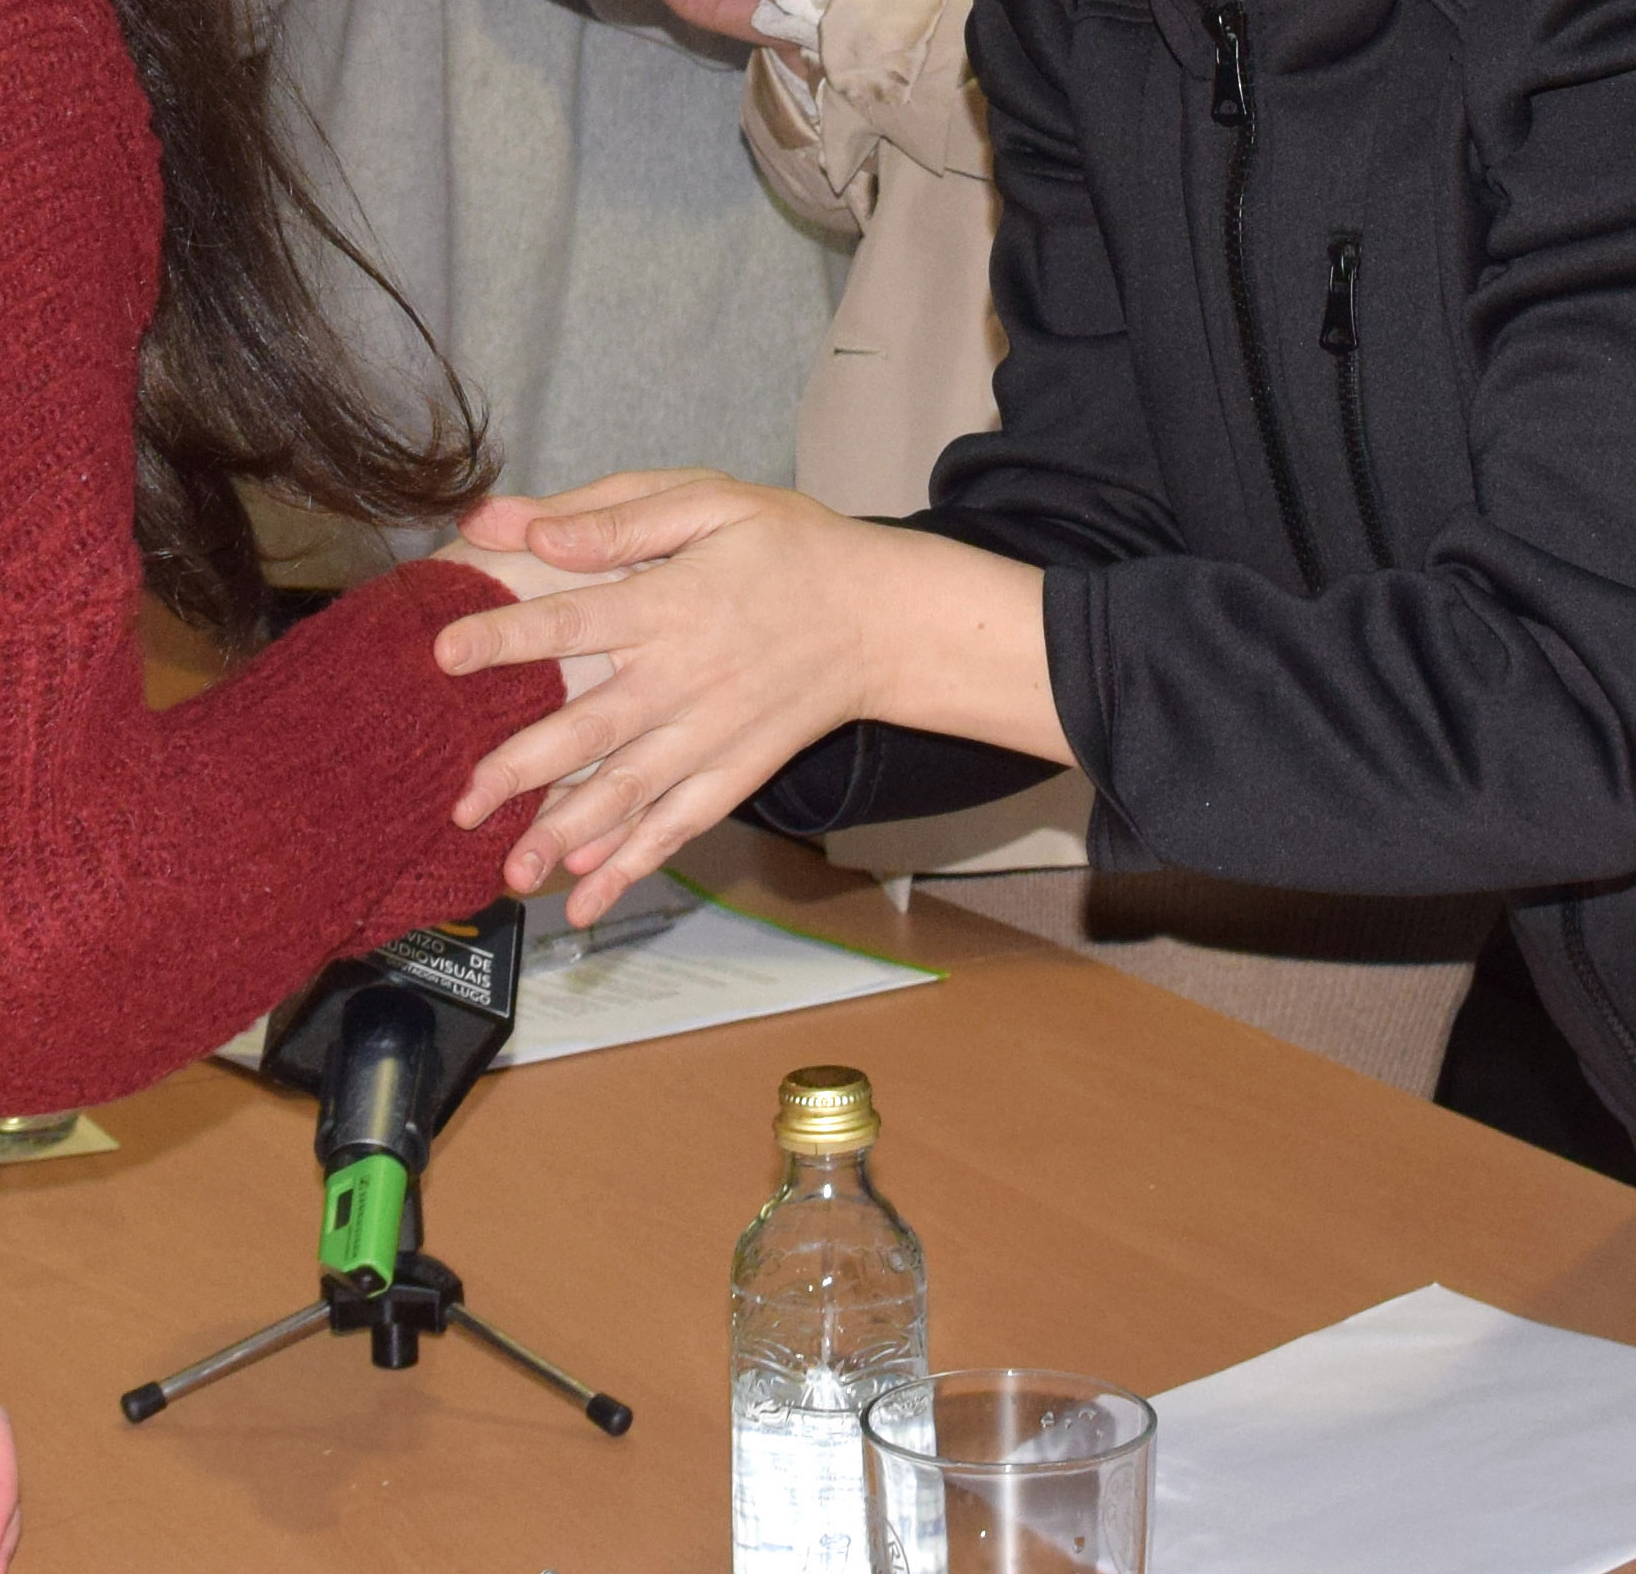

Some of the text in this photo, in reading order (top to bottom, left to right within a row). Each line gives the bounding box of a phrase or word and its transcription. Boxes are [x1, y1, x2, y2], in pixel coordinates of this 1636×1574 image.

[384, 938, 492, 989] UDIOVISUAIS
[469, 953, 492, 974] DE
[452, 983, 491, 1006] LUGO
